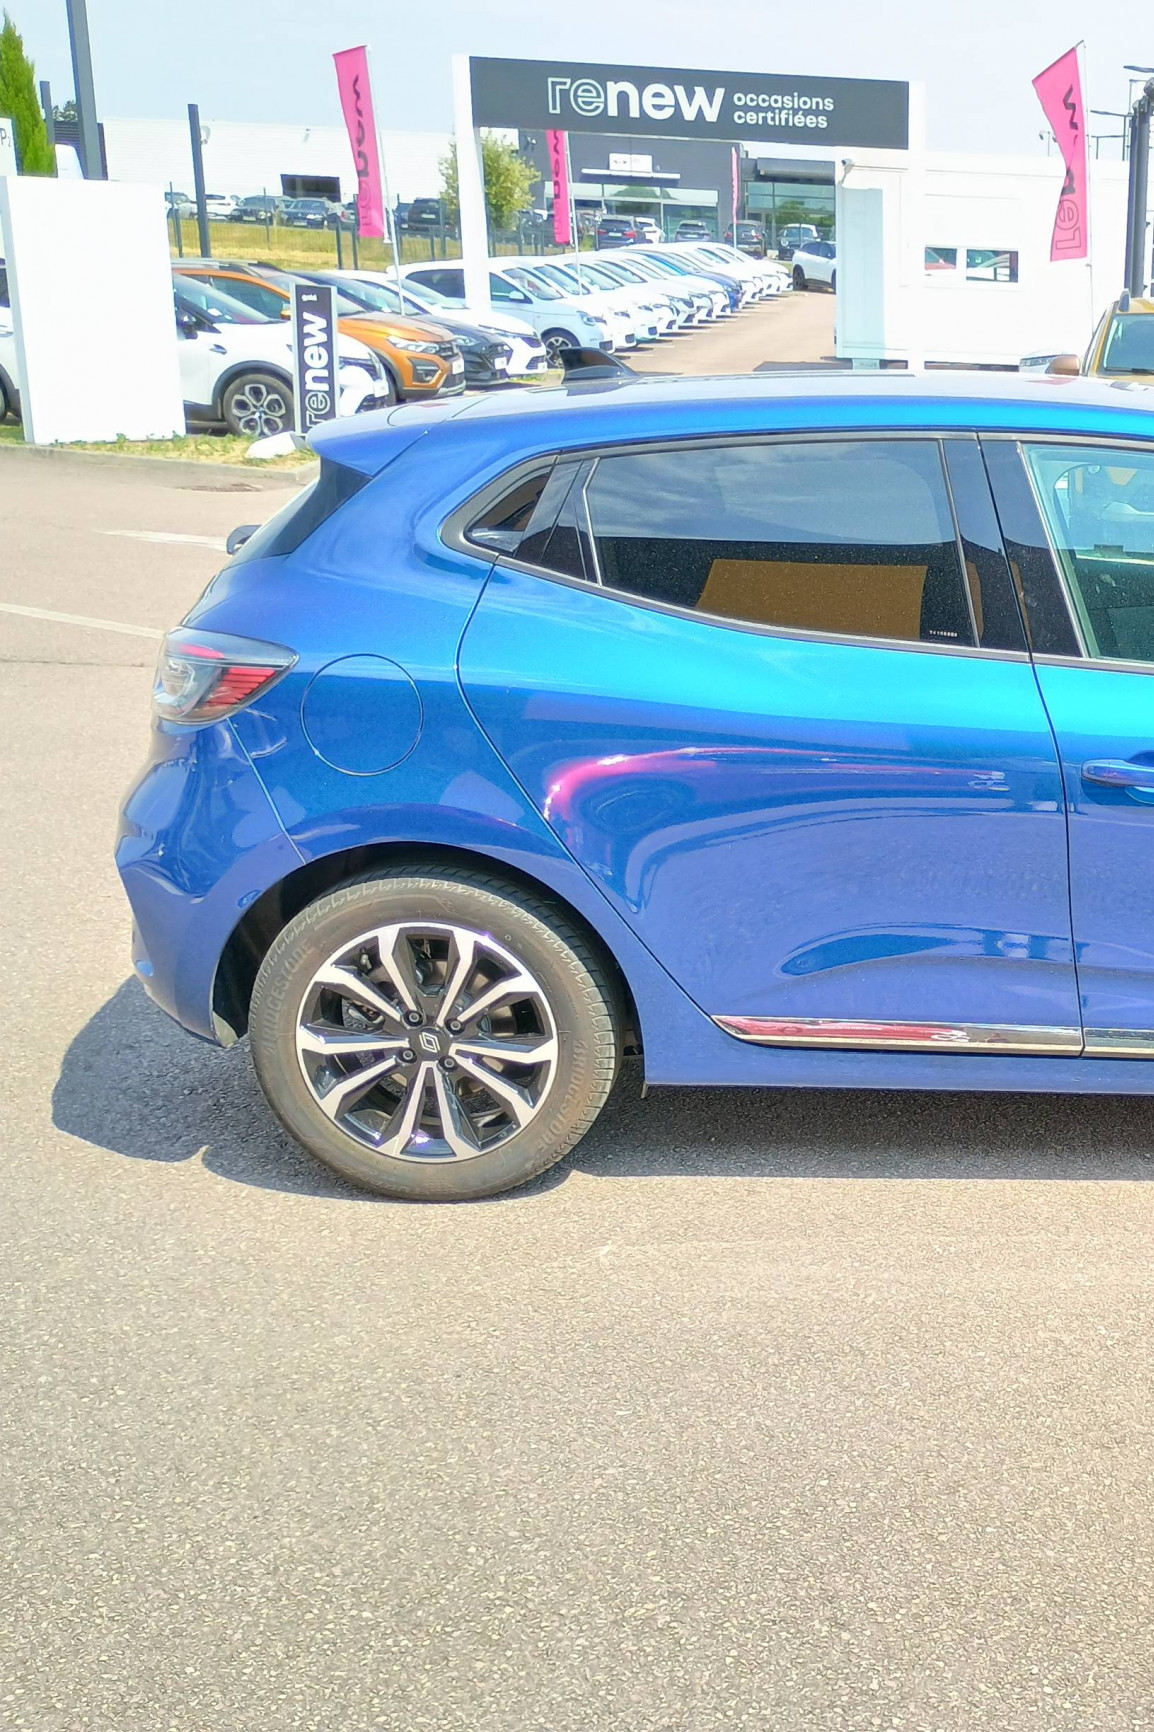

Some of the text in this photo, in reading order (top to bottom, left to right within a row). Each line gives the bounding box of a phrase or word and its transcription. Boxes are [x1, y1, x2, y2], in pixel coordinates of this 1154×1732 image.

[547, 77, 726, 123] renew
[733, 92, 834, 111] occasions
[733, 109, 828, 129] certifiées
[303, 311, 331, 427] renew
